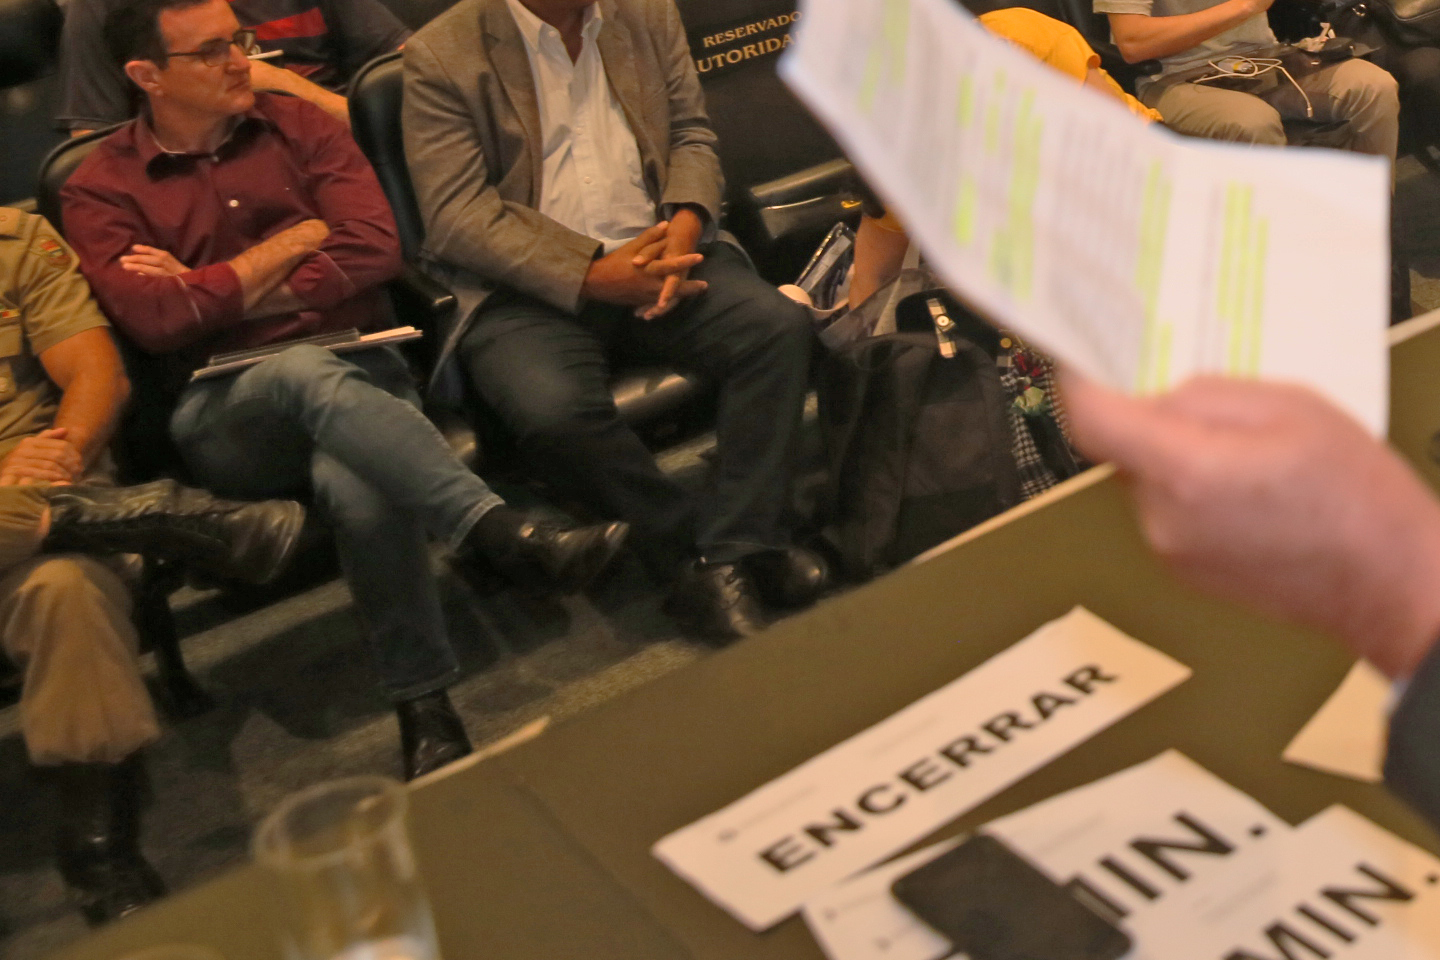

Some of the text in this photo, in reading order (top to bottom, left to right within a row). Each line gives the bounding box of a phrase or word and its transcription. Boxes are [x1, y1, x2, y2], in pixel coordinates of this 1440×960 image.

[702, 10, 802, 48] RESERVADO
[695, 33, 797, 74] UTORIDA
[756, 663, 1119, 873] ENCERRAR
